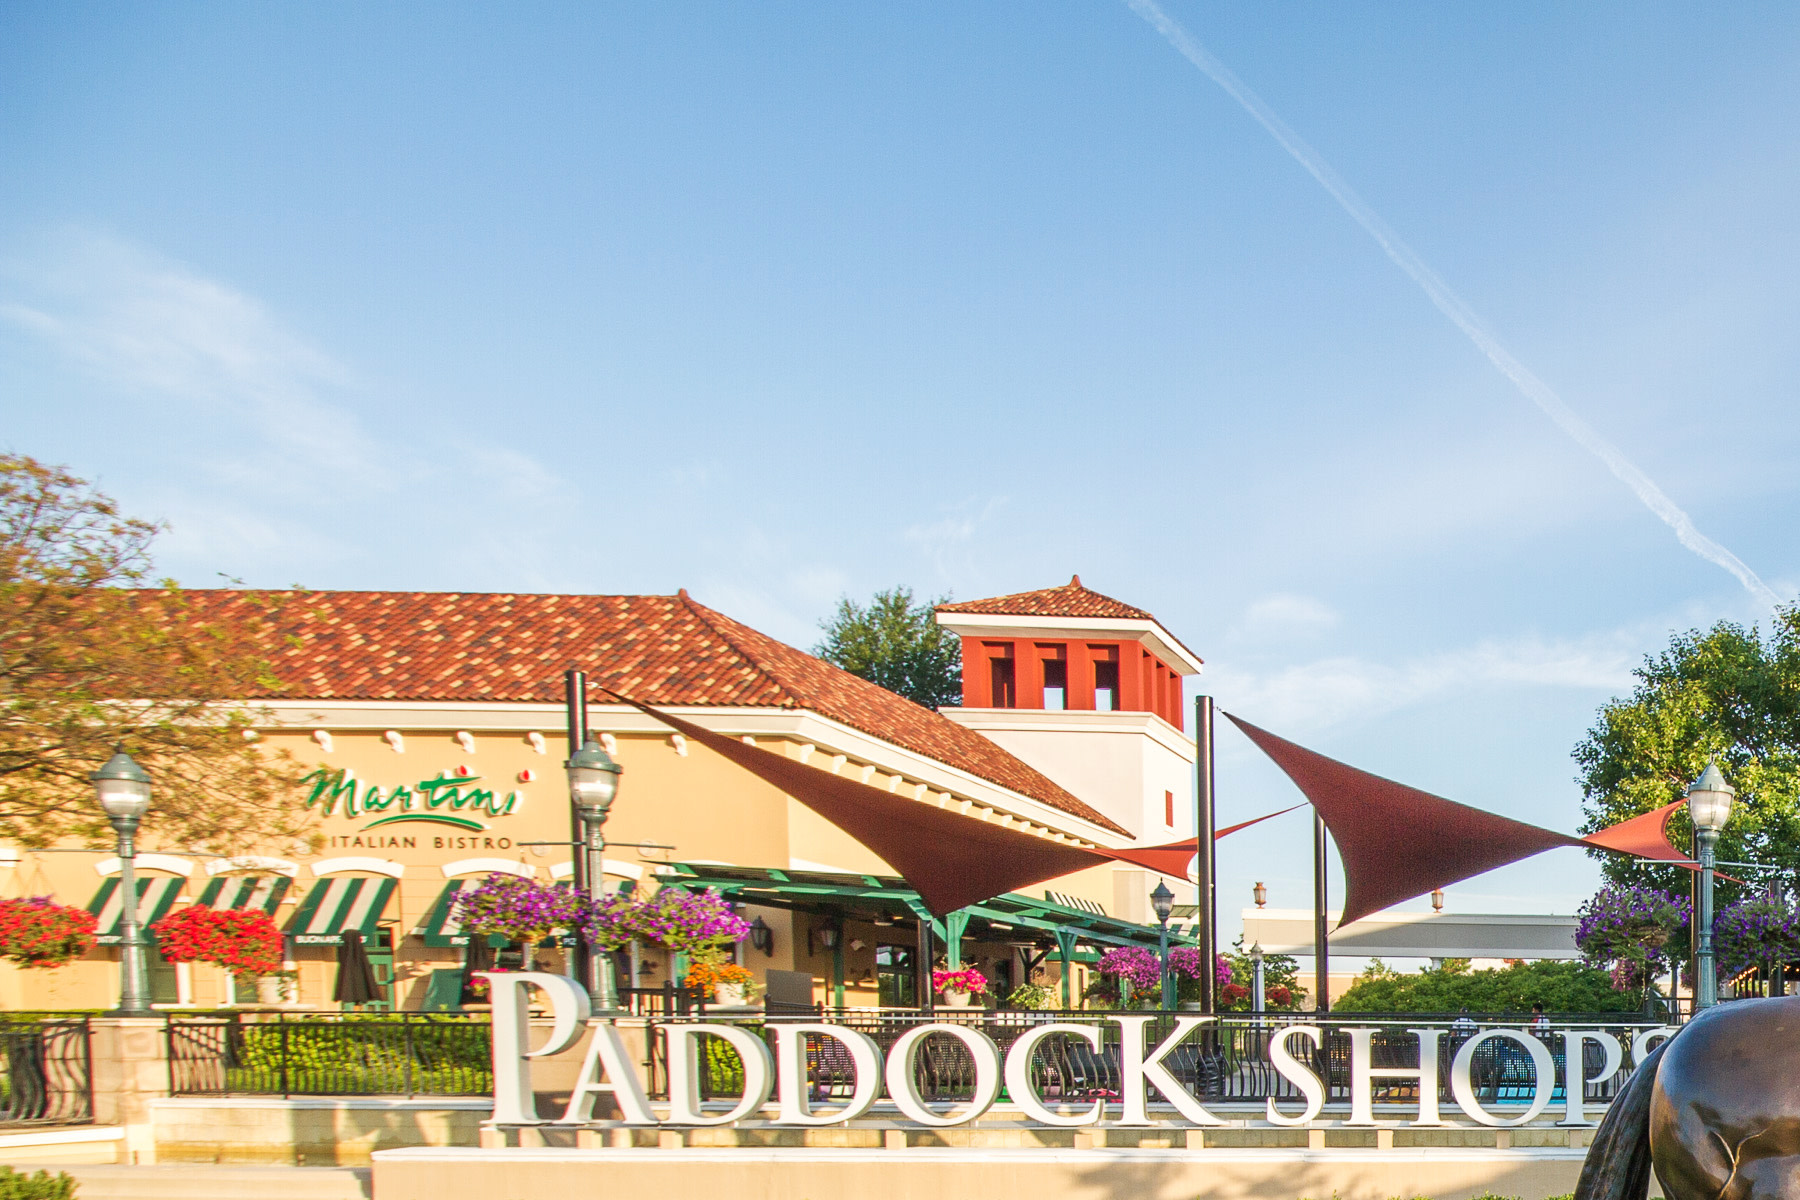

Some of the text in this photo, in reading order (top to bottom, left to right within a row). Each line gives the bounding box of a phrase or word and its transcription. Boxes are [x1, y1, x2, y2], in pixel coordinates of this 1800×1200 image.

[300, 766, 533, 818] Martini
[331, 835, 512, 850] ITALIAN BISTRO
[471, 970, 1231, 1127] PADDOCK
